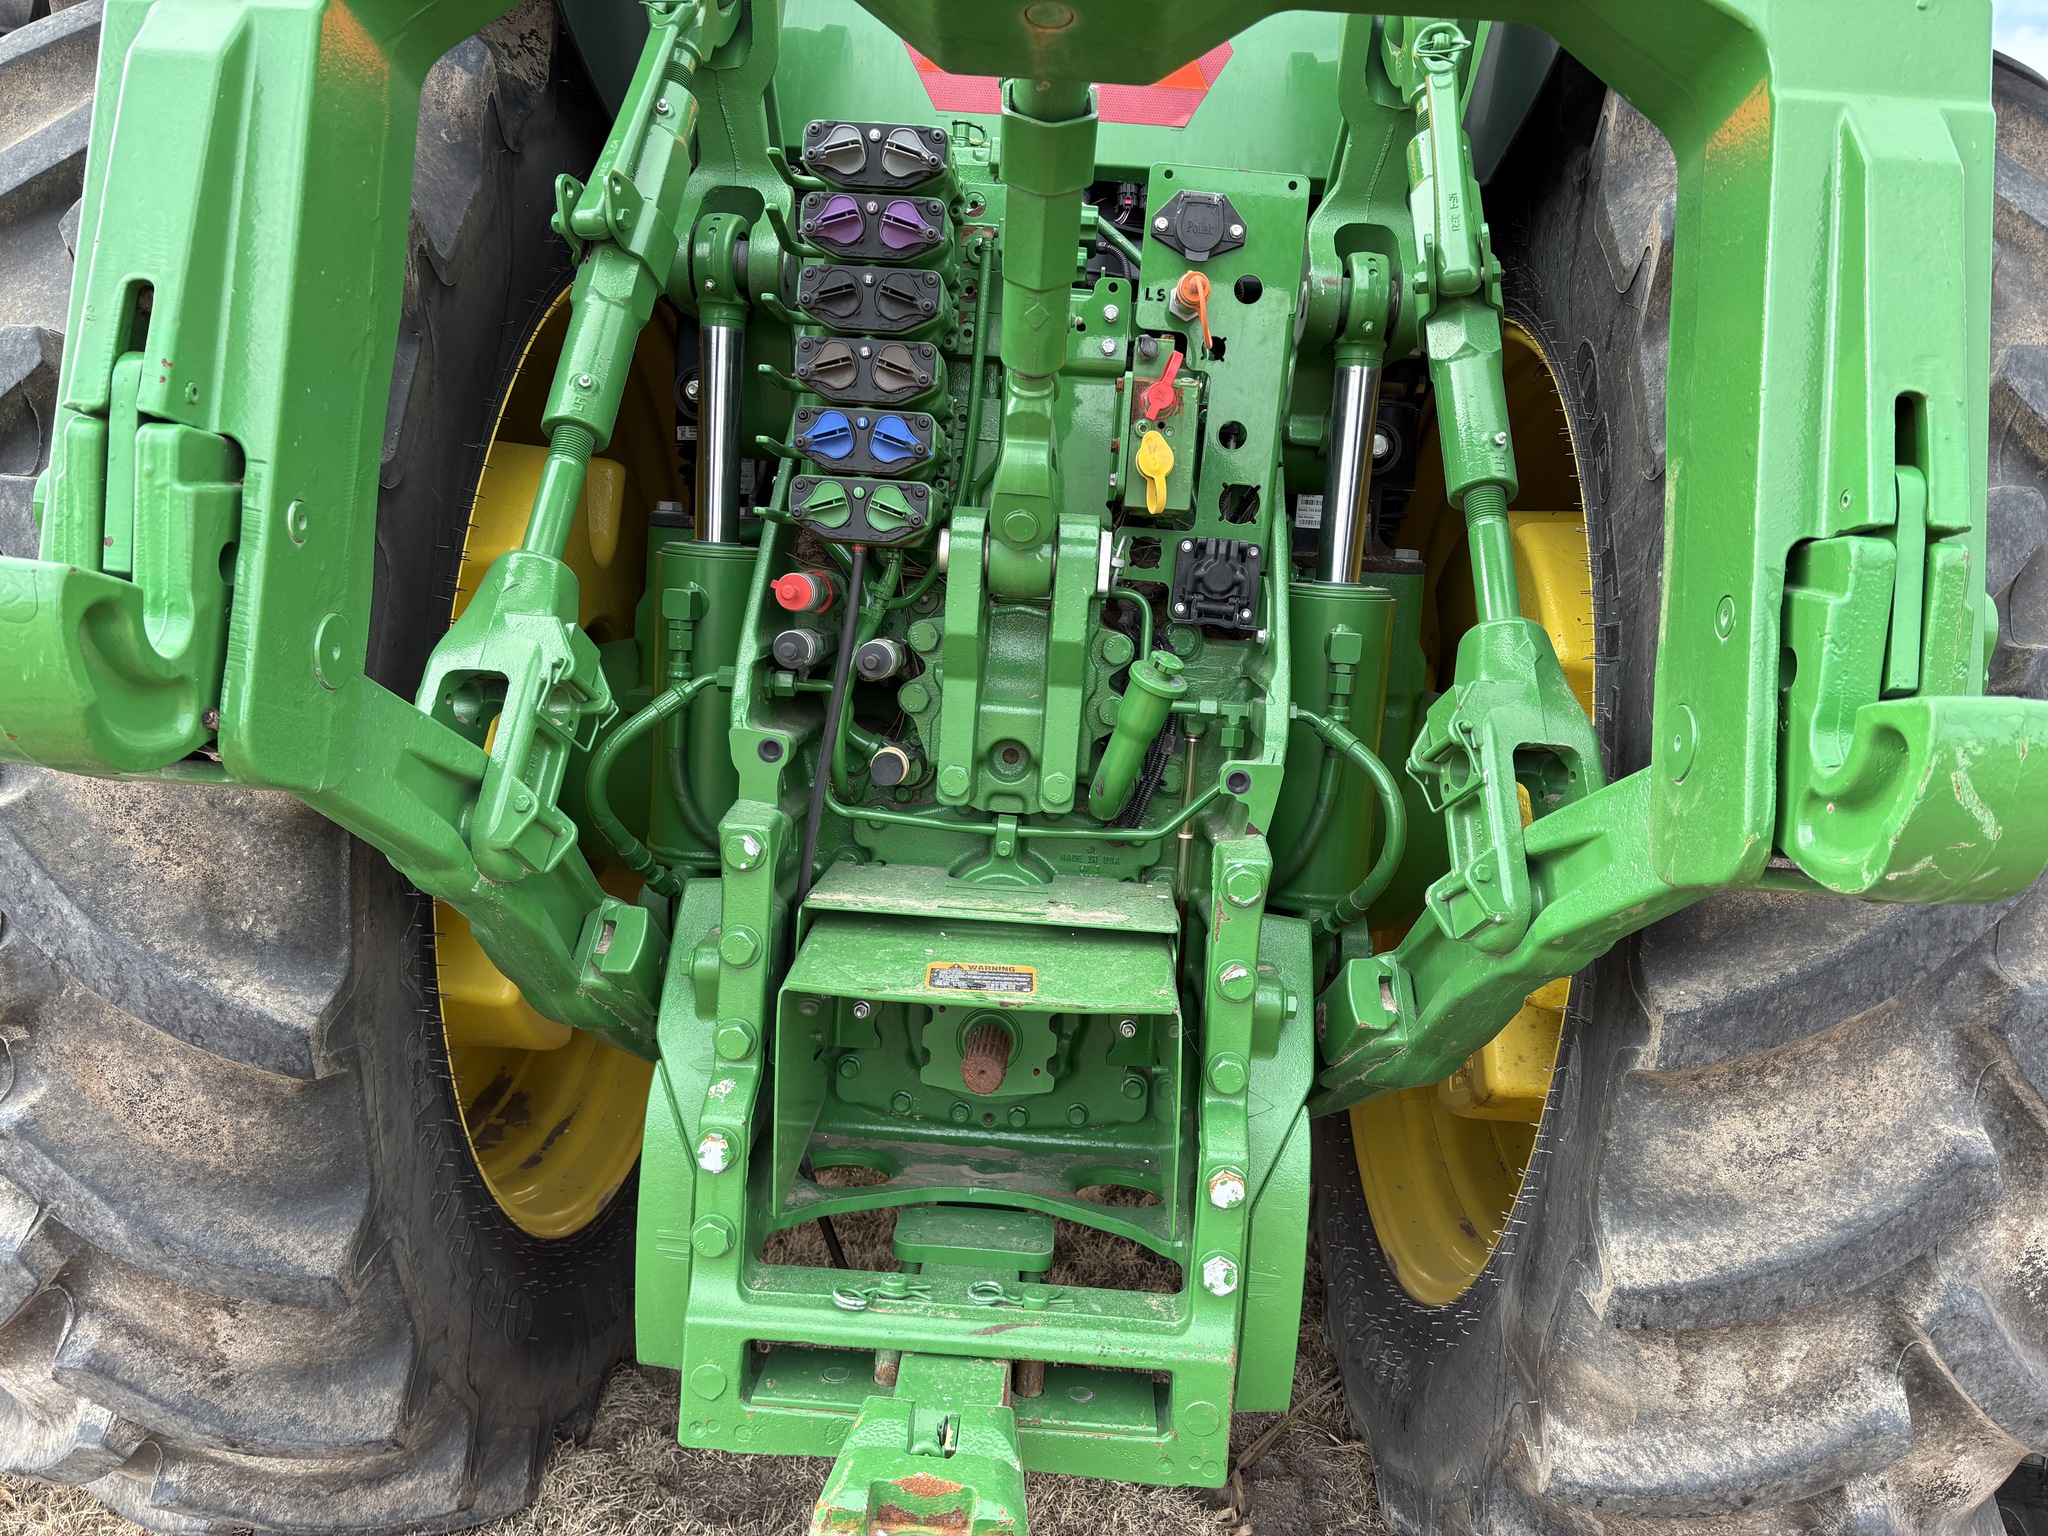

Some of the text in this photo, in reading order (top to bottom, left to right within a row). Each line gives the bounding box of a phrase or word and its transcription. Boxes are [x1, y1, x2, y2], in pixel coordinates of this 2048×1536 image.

[1186, 220, 1214, 236] Pollak
[1060, 853, 1120, 866] MADE IN USA
[968, 964, 1016, 972] WARNING
